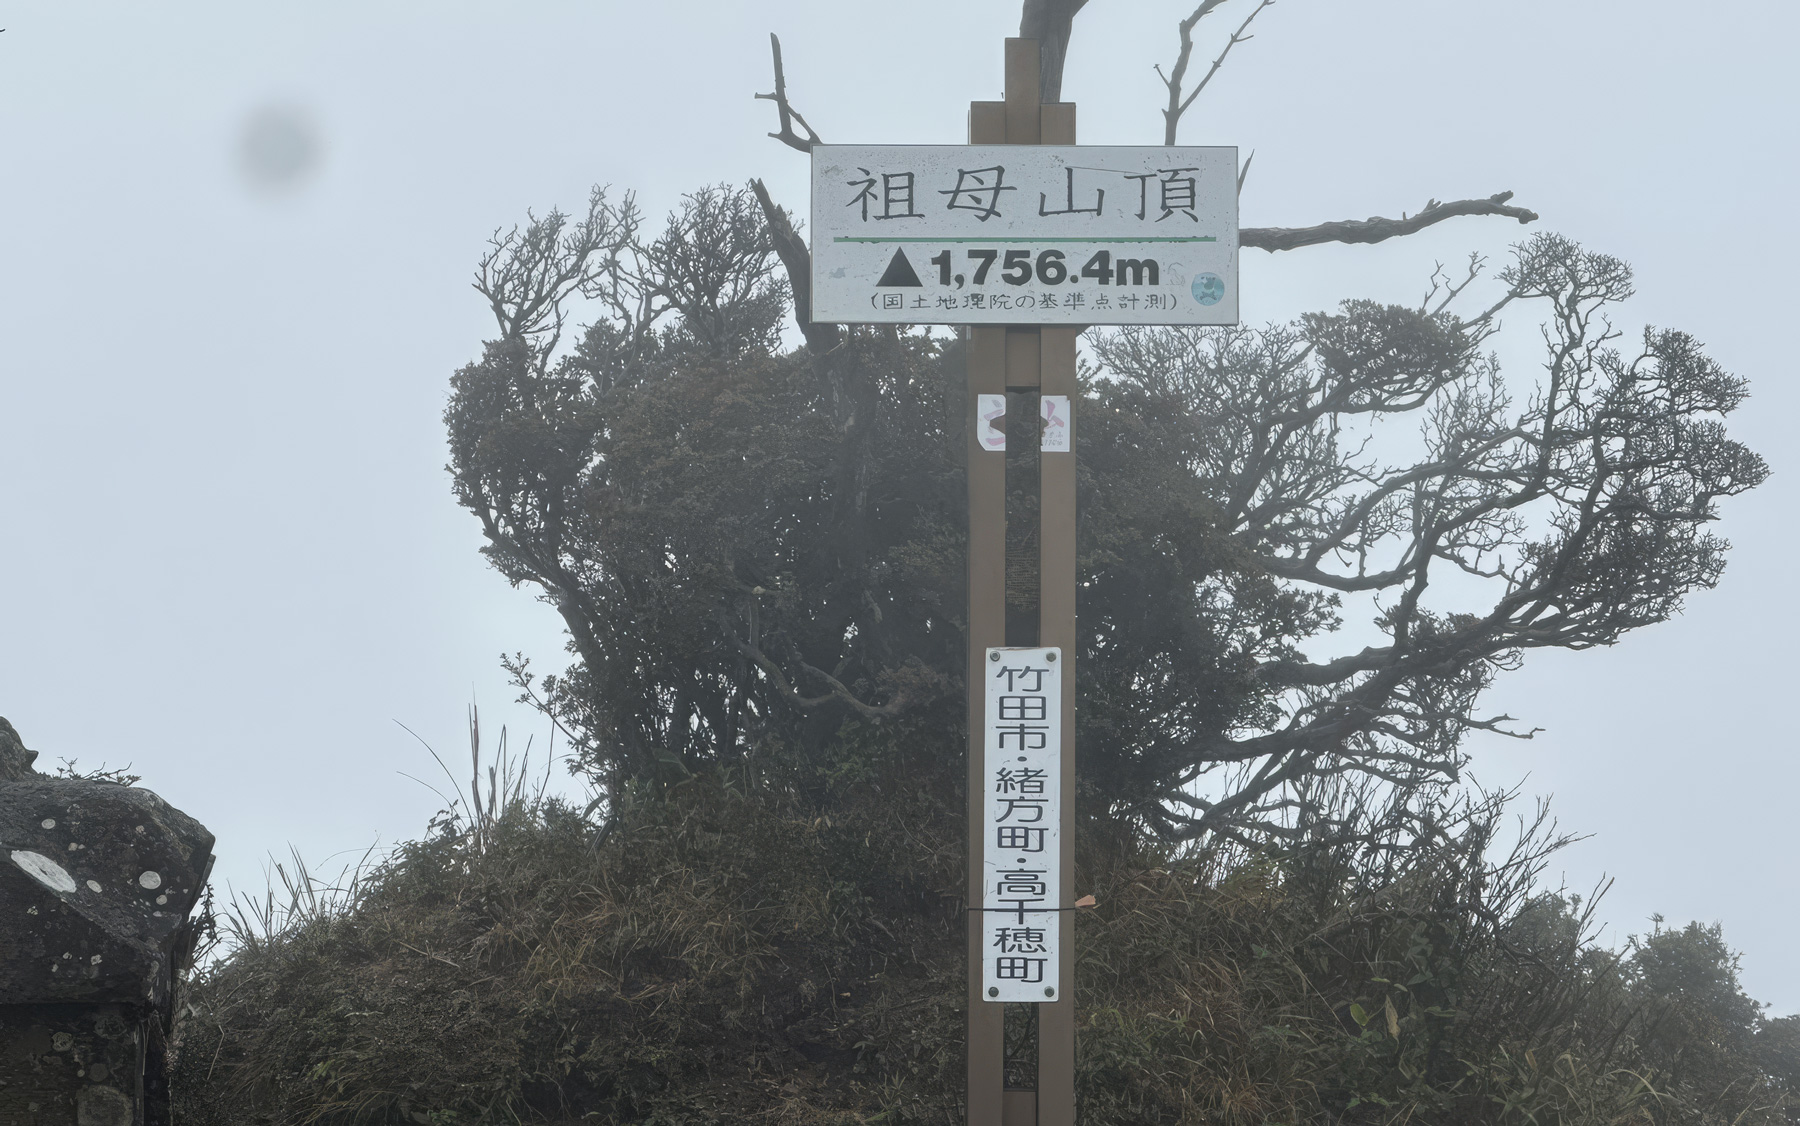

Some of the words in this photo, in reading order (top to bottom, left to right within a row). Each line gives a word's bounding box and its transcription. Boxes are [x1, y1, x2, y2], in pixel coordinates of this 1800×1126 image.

[846, 165, 1200, 223] 祖母山頂
[930, 249, 1160, 290] 1,756.4m
